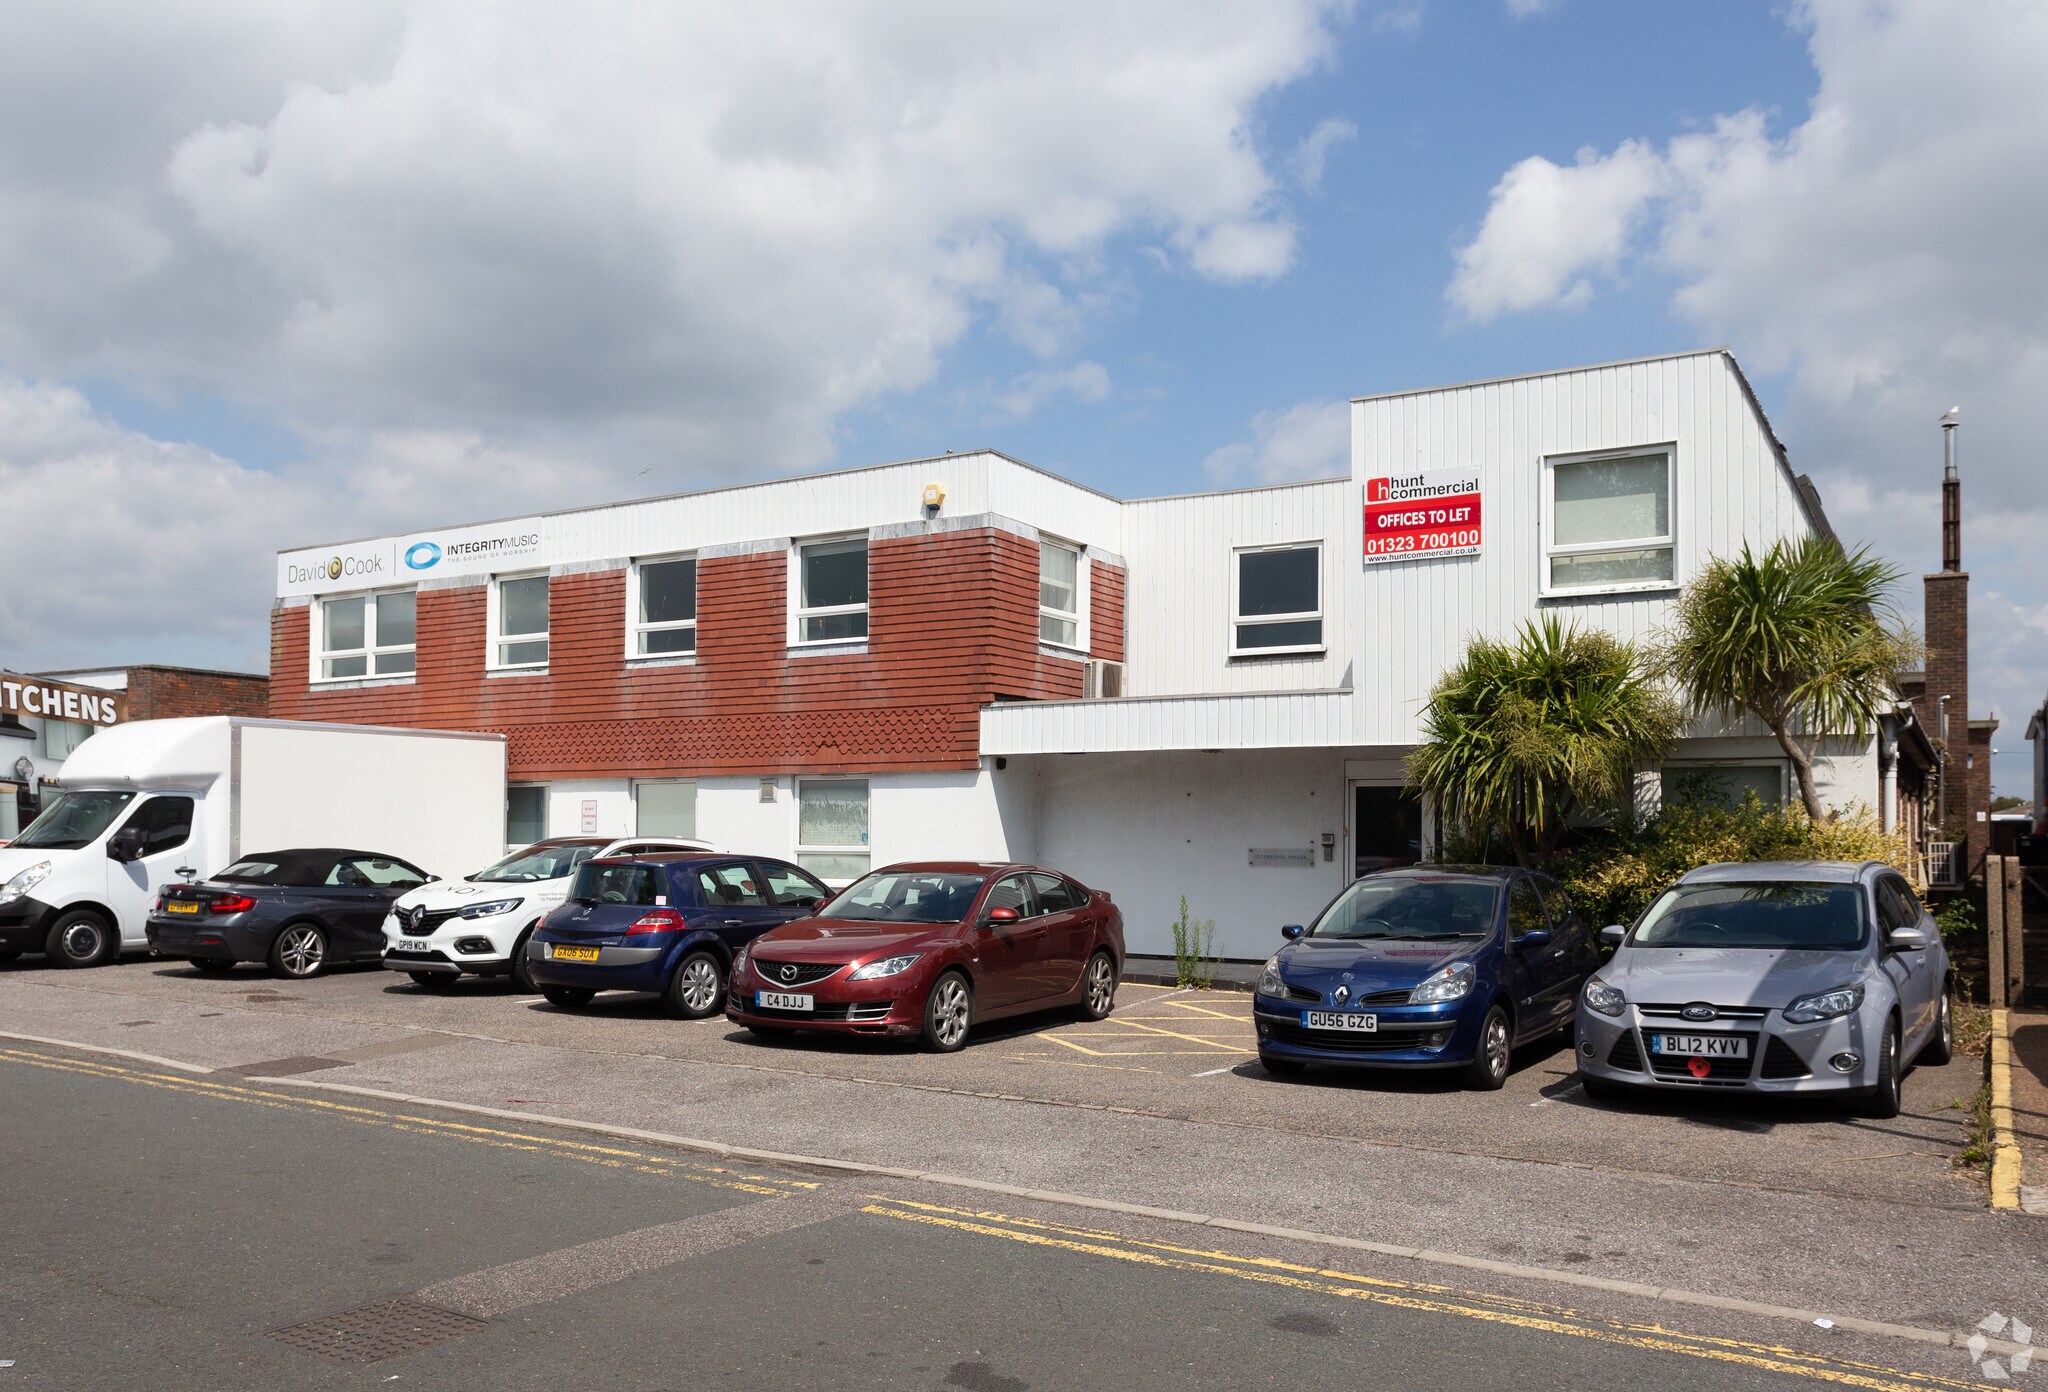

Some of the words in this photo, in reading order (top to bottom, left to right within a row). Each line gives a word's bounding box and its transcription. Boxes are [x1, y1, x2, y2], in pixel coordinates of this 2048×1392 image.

[1390, 478, 1479, 500] commercial
[1391, 474, 1425, 489] hunt
[1377, 511, 1426, 528] OFFICES
[1428, 510, 1447, 524] TO
[1449, 507, 1471, 522] LET
[1367, 536, 1415, 554] 01323
[1419, 530, 1479, 549] 700100
[463, 553, 487, 562] SOUND
[502, 547, 537, 557] WORSHIP
[1368, 547, 1478, 562] www.huntcommercial.co.uk
[399, 940, 413, 950] GP19
[414, 940, 427, 950] WCN
[557, 946, 577, 957] GX06
[578, 948, 595, 959] SOA
[767, 994, 780, 1006] C4
[782, 996, 804, 1008] DJJ
[1689, 1008, 1708, 1016] Ford
[1310, 1012, 1344, 1028] GU56
[1347, 1015, 1374, 1029] GZG
[1666, 1036, 1702, 1053] BL12
[1707, 1039, 1740, 1055] KVV
